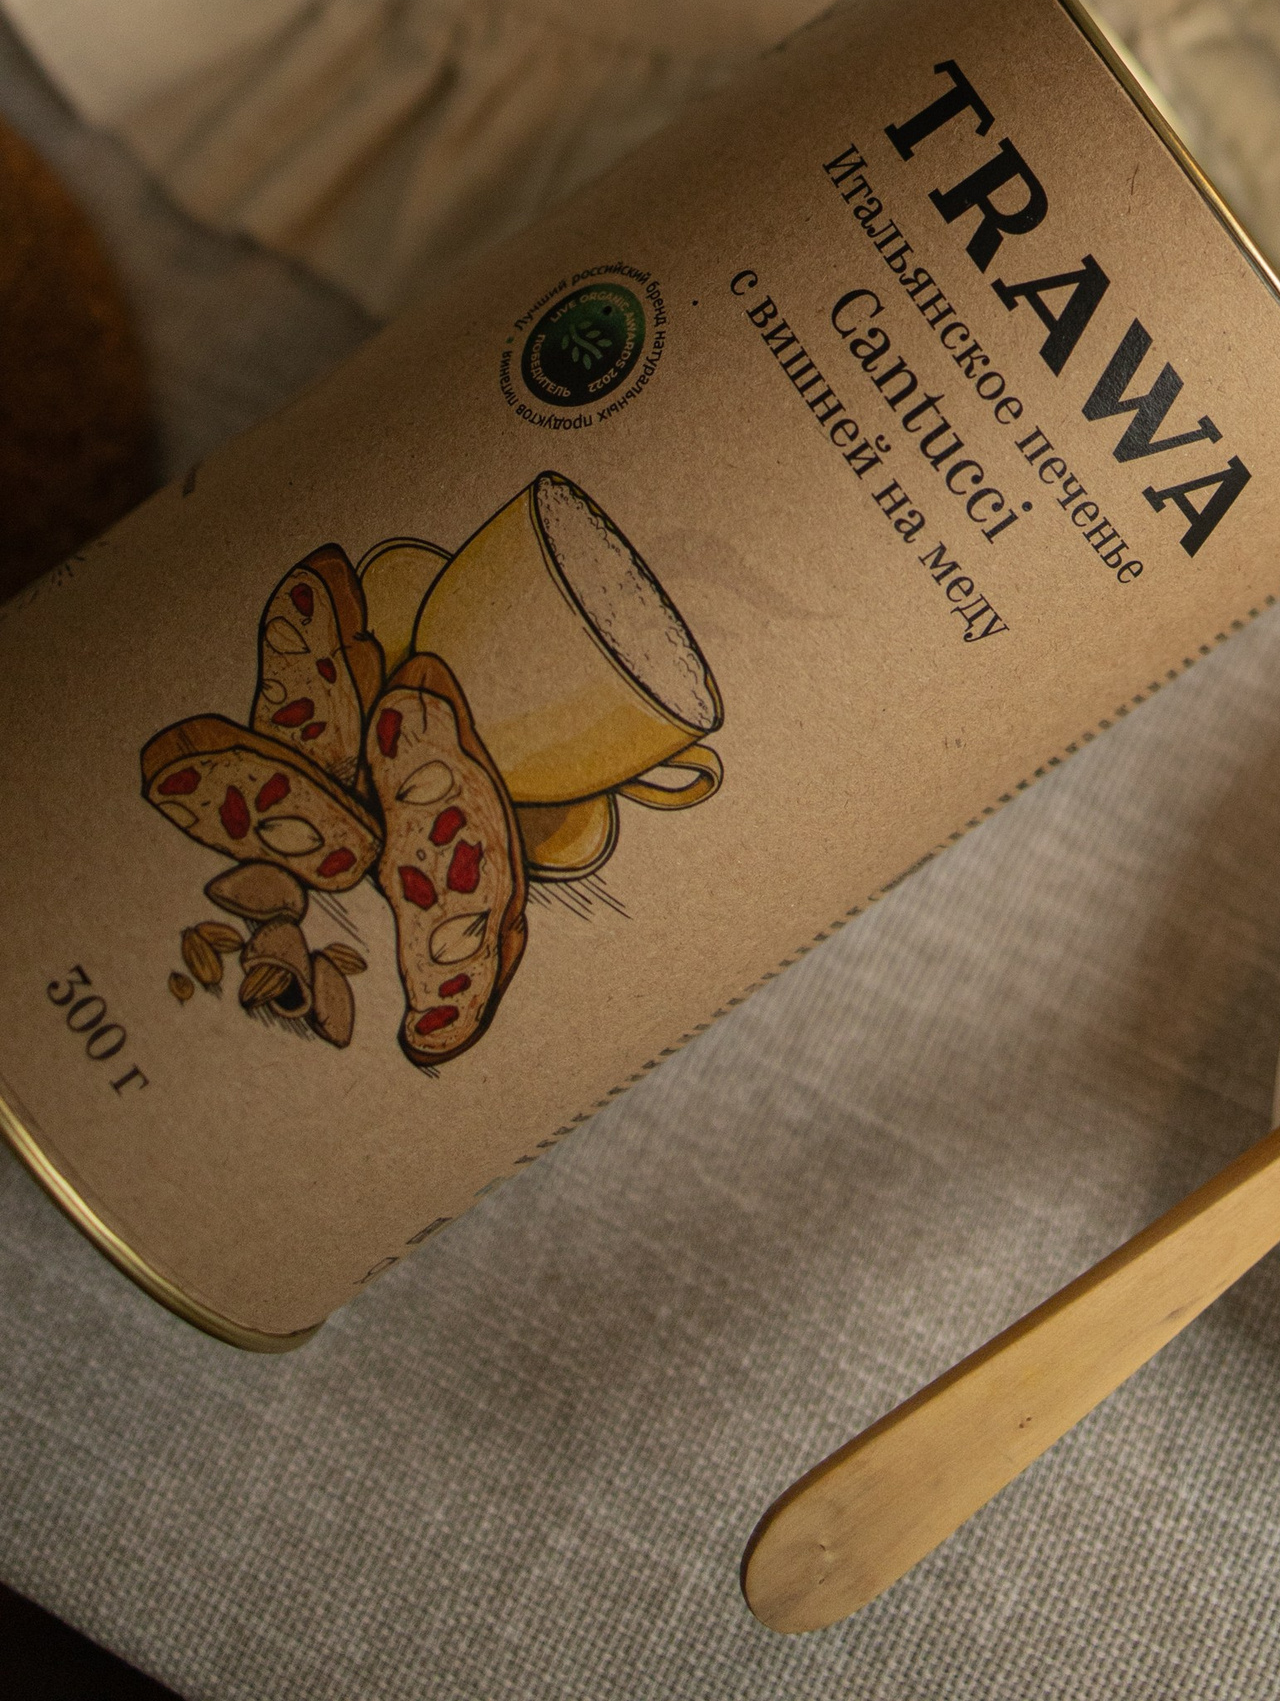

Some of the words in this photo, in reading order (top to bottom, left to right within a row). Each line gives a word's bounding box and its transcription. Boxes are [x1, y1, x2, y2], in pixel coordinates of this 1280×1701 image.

[571, 261, 652, 287] российский
[646, 280, 668, 327] бренд
[514, 279, 567, 331] Лучший
[550, 299, 577, 324] LIVE
[884, 59, 1252, 558] TRAWA
[530, 333, 572, 398] ПОБЕДИТЕЛЬ
[615, 310, 638, 370] AWARDS
[821, 143, 1025, 426] Итальянское
[1013, 425, 1144, 585] печенье
[499, 350, 519, 407] питания
[587, 368, 619, 394] 2022
[597, 329, 667, 422] натуральных
[515, 403, 593, 431] продуктов
[829, 288, 1033, 544] Cantucci
[729, 268, 759, 298] с
[745, 295, 892, 481] вишней
[871, 477, 928, 544] на
[918, 540, 1010, 644] меду
[46, 964, 128, 1061] 300
